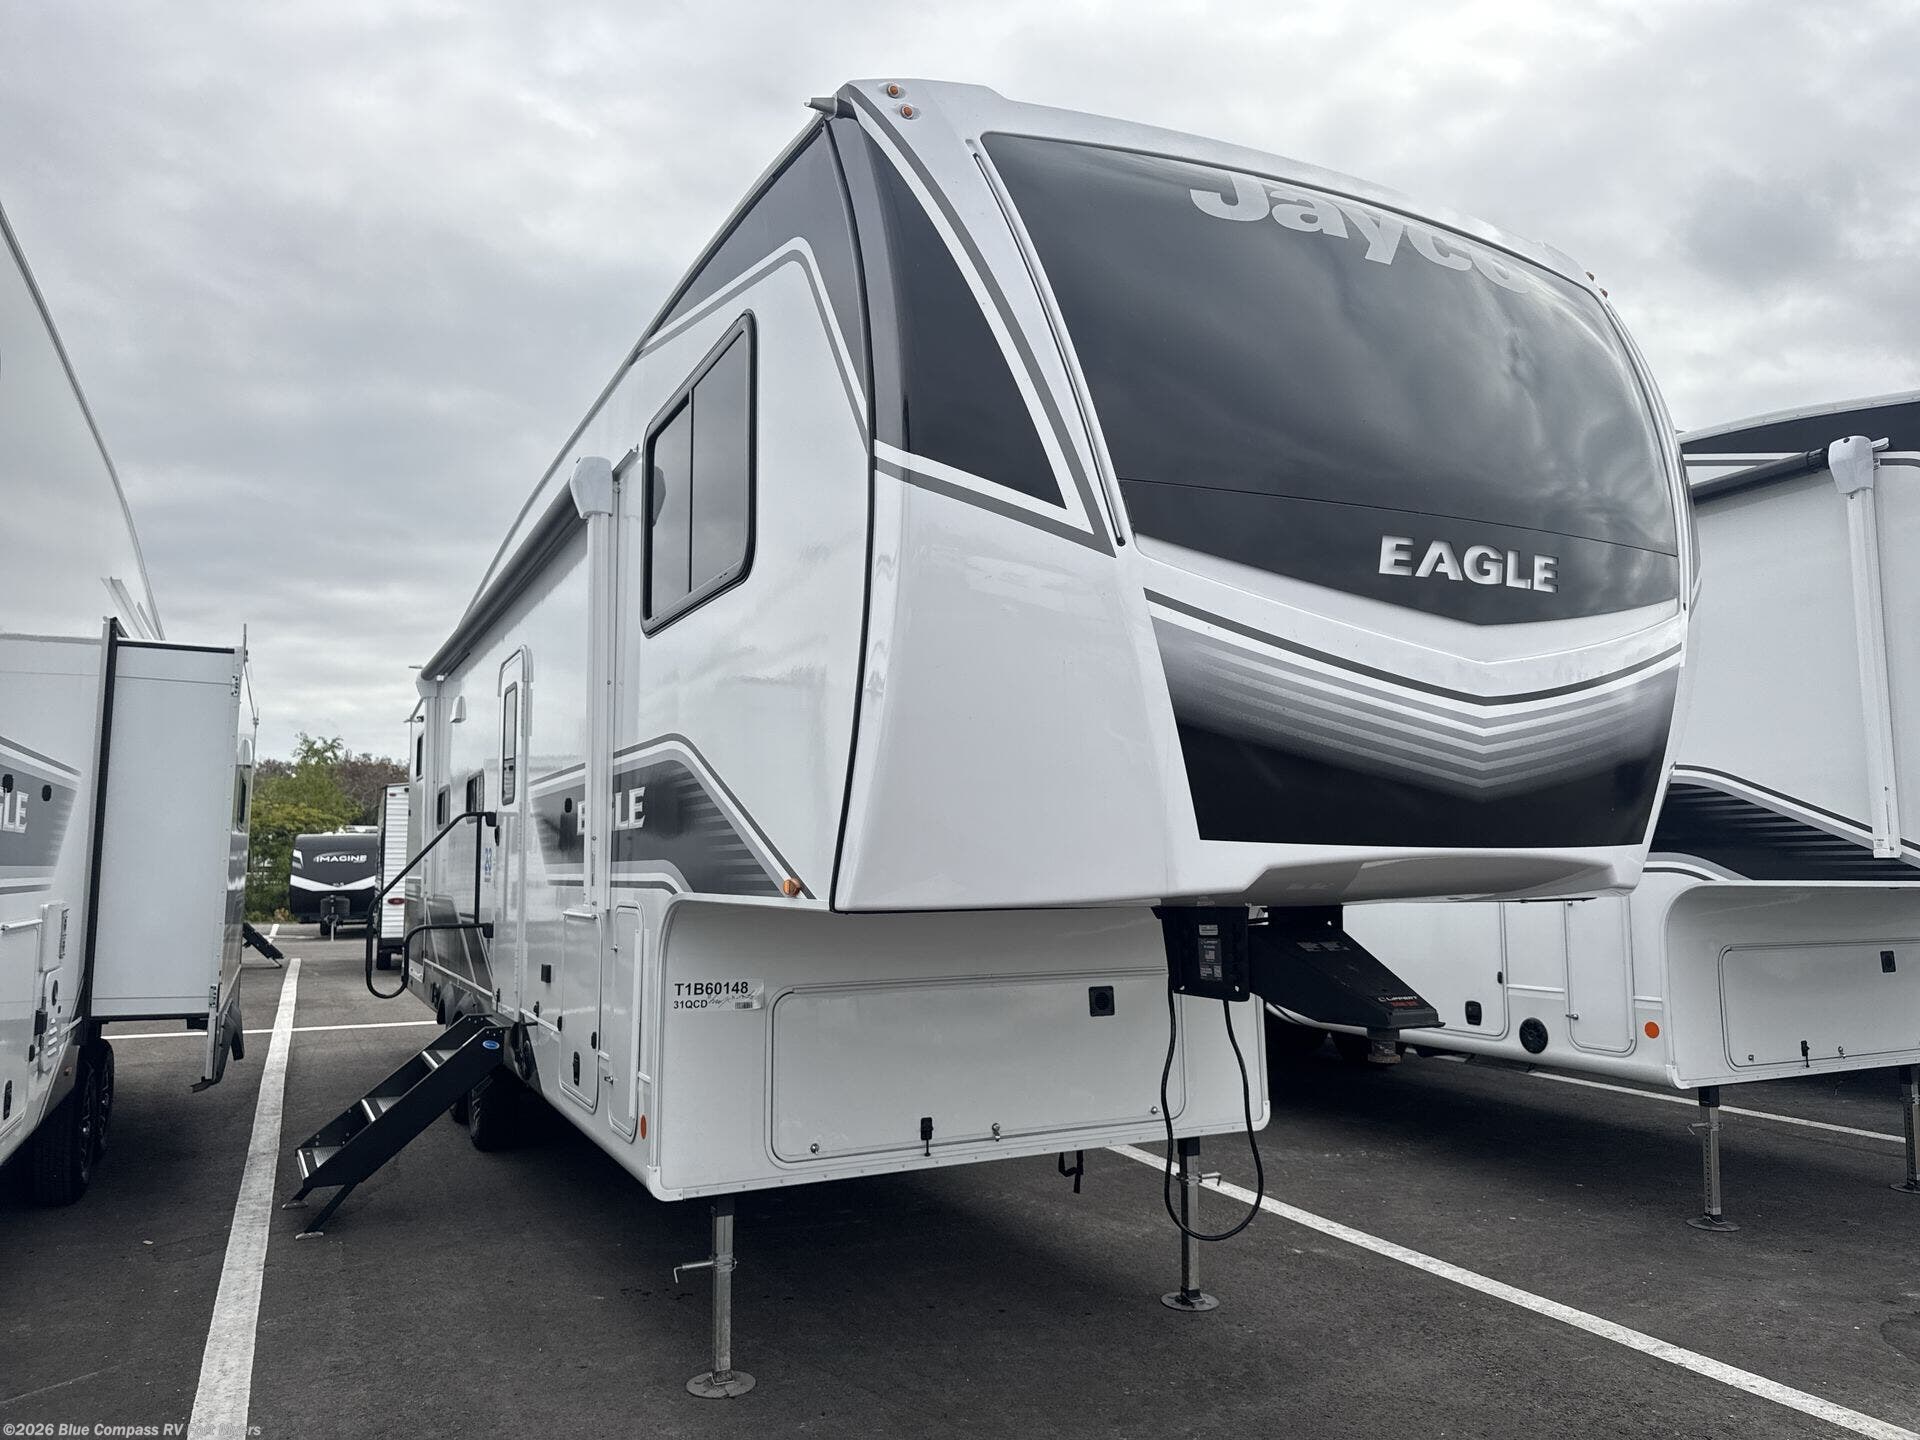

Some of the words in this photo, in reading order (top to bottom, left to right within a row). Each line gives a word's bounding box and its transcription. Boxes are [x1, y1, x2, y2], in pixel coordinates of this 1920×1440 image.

[1378, 534, 1560, 593] EAGLE
[576, 786, 646, 836] ELE
[314, 854, 367, 863] IMAGINE
[674, 981, 749, 996] T1B60148
[673, 999, 708, 1010] 31QCD
